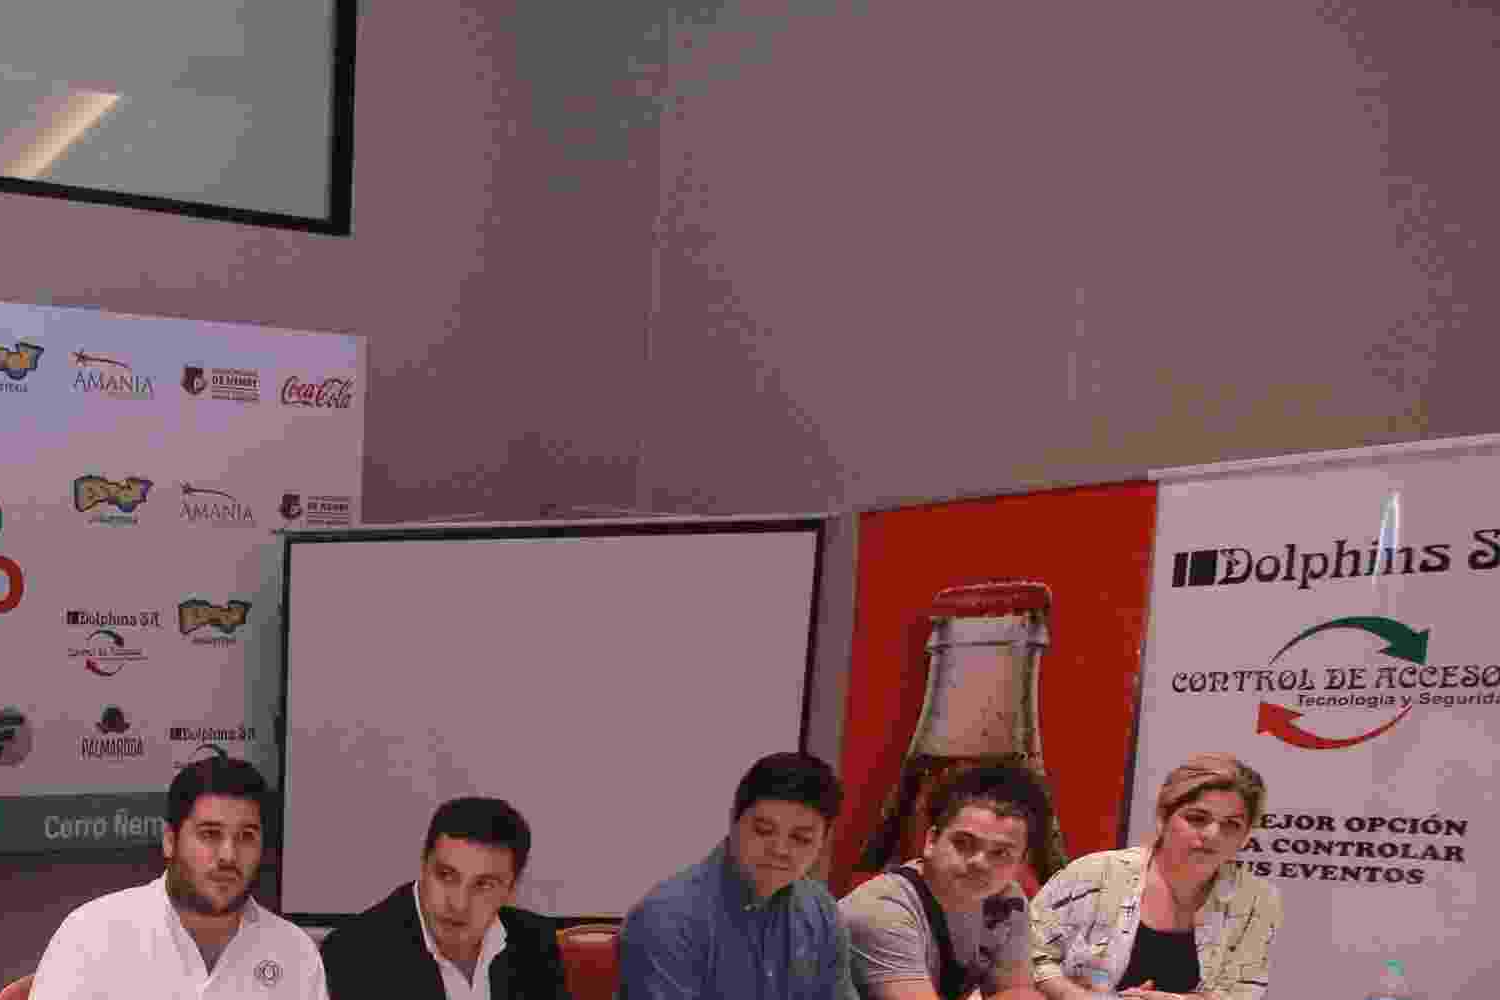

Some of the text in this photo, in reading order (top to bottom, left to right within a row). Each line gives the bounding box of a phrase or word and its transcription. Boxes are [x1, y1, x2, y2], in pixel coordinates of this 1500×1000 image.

[1217, 536, 1452, 591] Dolphins
[1171, 668, 1315, 693] CONTROL
[1323, 668, 1367, 690] DE
[1259, 813, 1469, 837] EJOR OPCIÓN
[1271, 837, 1466, 864] CONTROLAR
[1280, 861, 1425, 885] EVENTOS
